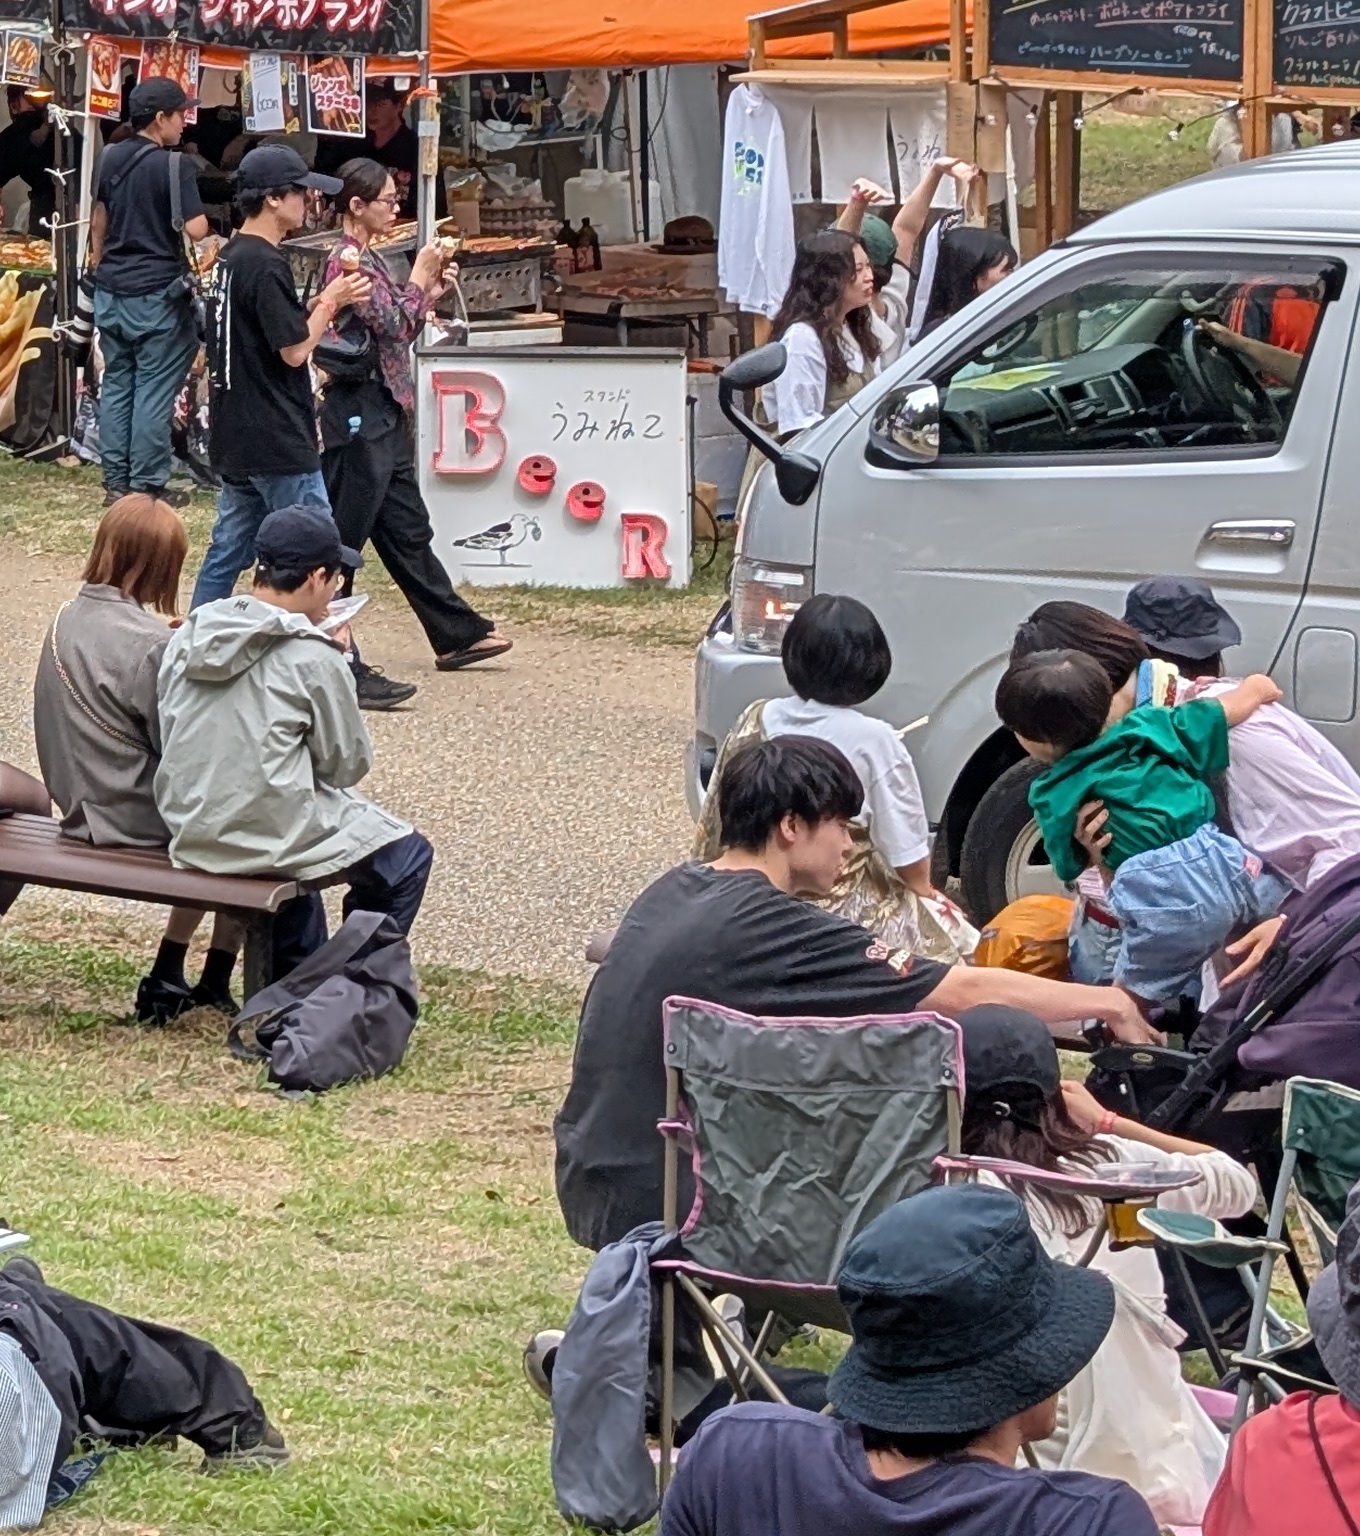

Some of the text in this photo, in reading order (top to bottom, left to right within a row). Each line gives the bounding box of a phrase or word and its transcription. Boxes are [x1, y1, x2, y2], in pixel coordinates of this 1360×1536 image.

[583, 388, 632, 403] スタンド
[551, 401, 664, 442] うみねこ
